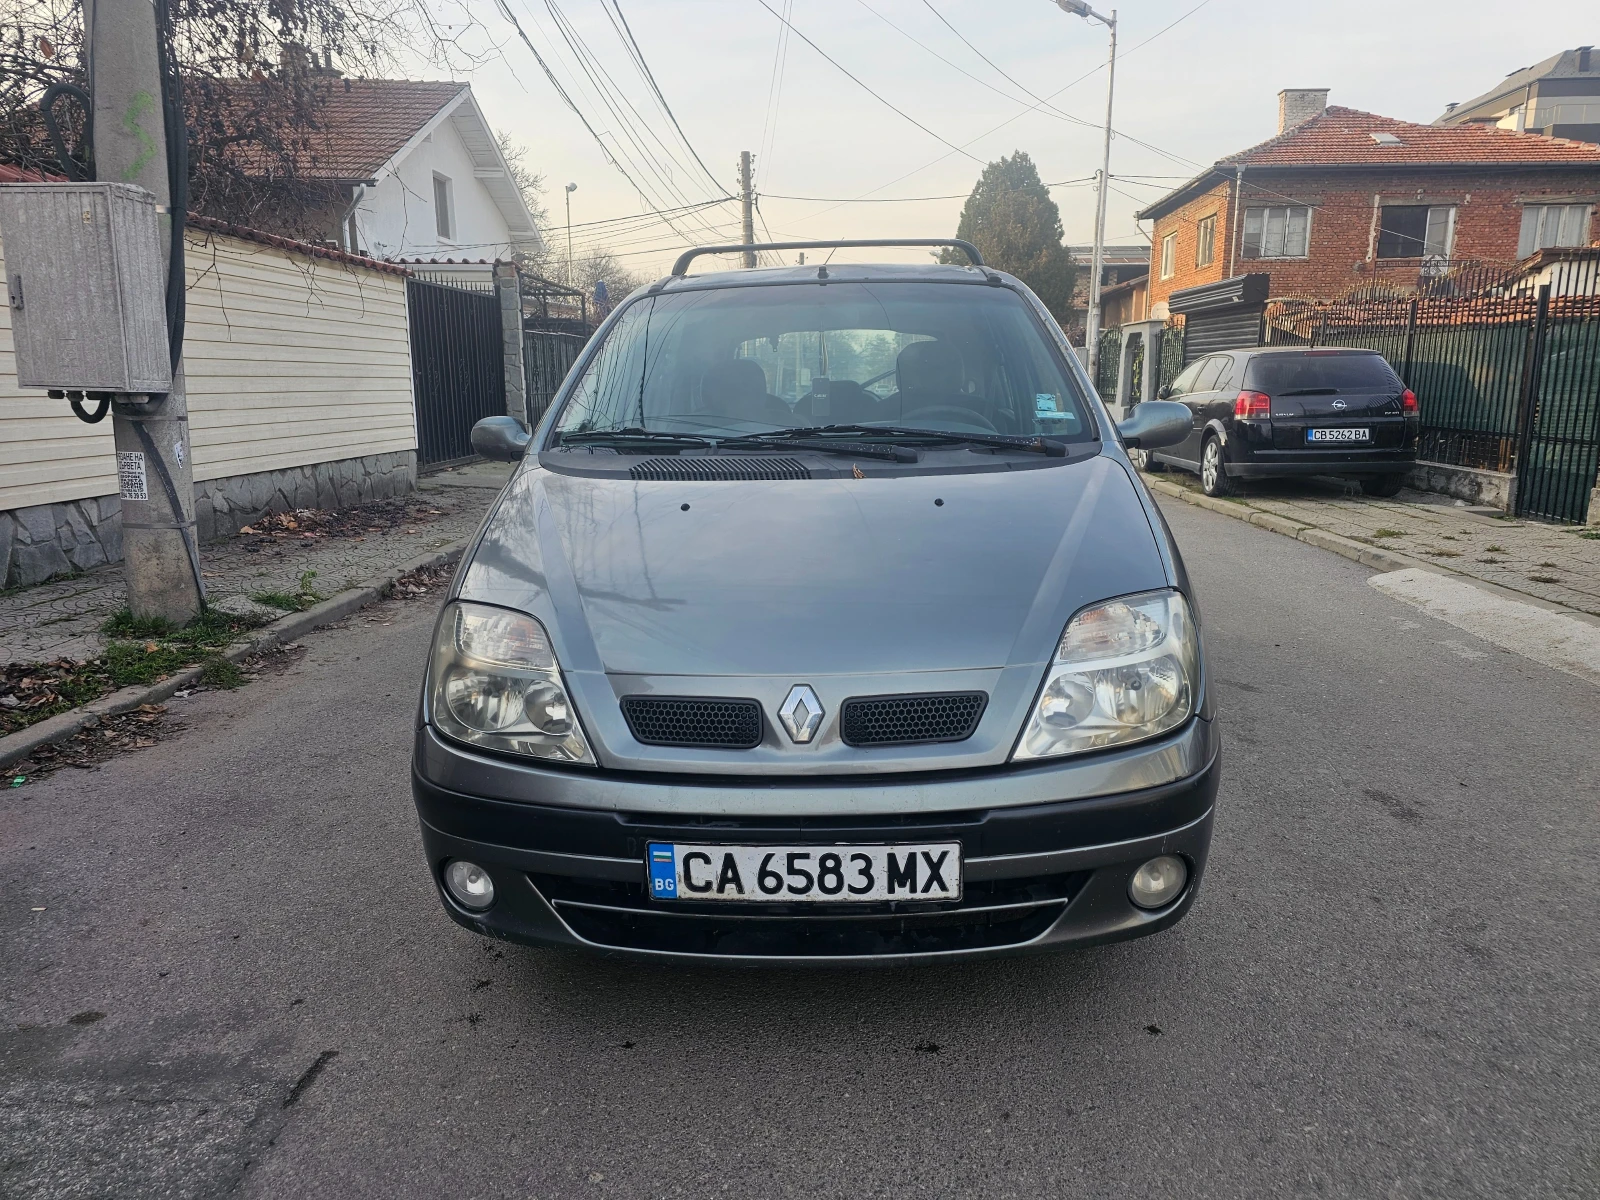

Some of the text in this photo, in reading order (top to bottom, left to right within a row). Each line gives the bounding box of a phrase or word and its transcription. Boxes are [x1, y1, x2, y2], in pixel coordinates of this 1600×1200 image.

[1314, 430, 1367, 440] CB 5262 BA
[134, 452, 144, 461] НА
[682, 850, 950, 895] CA 6583 MX
[655, 878, 675, 891] BG
